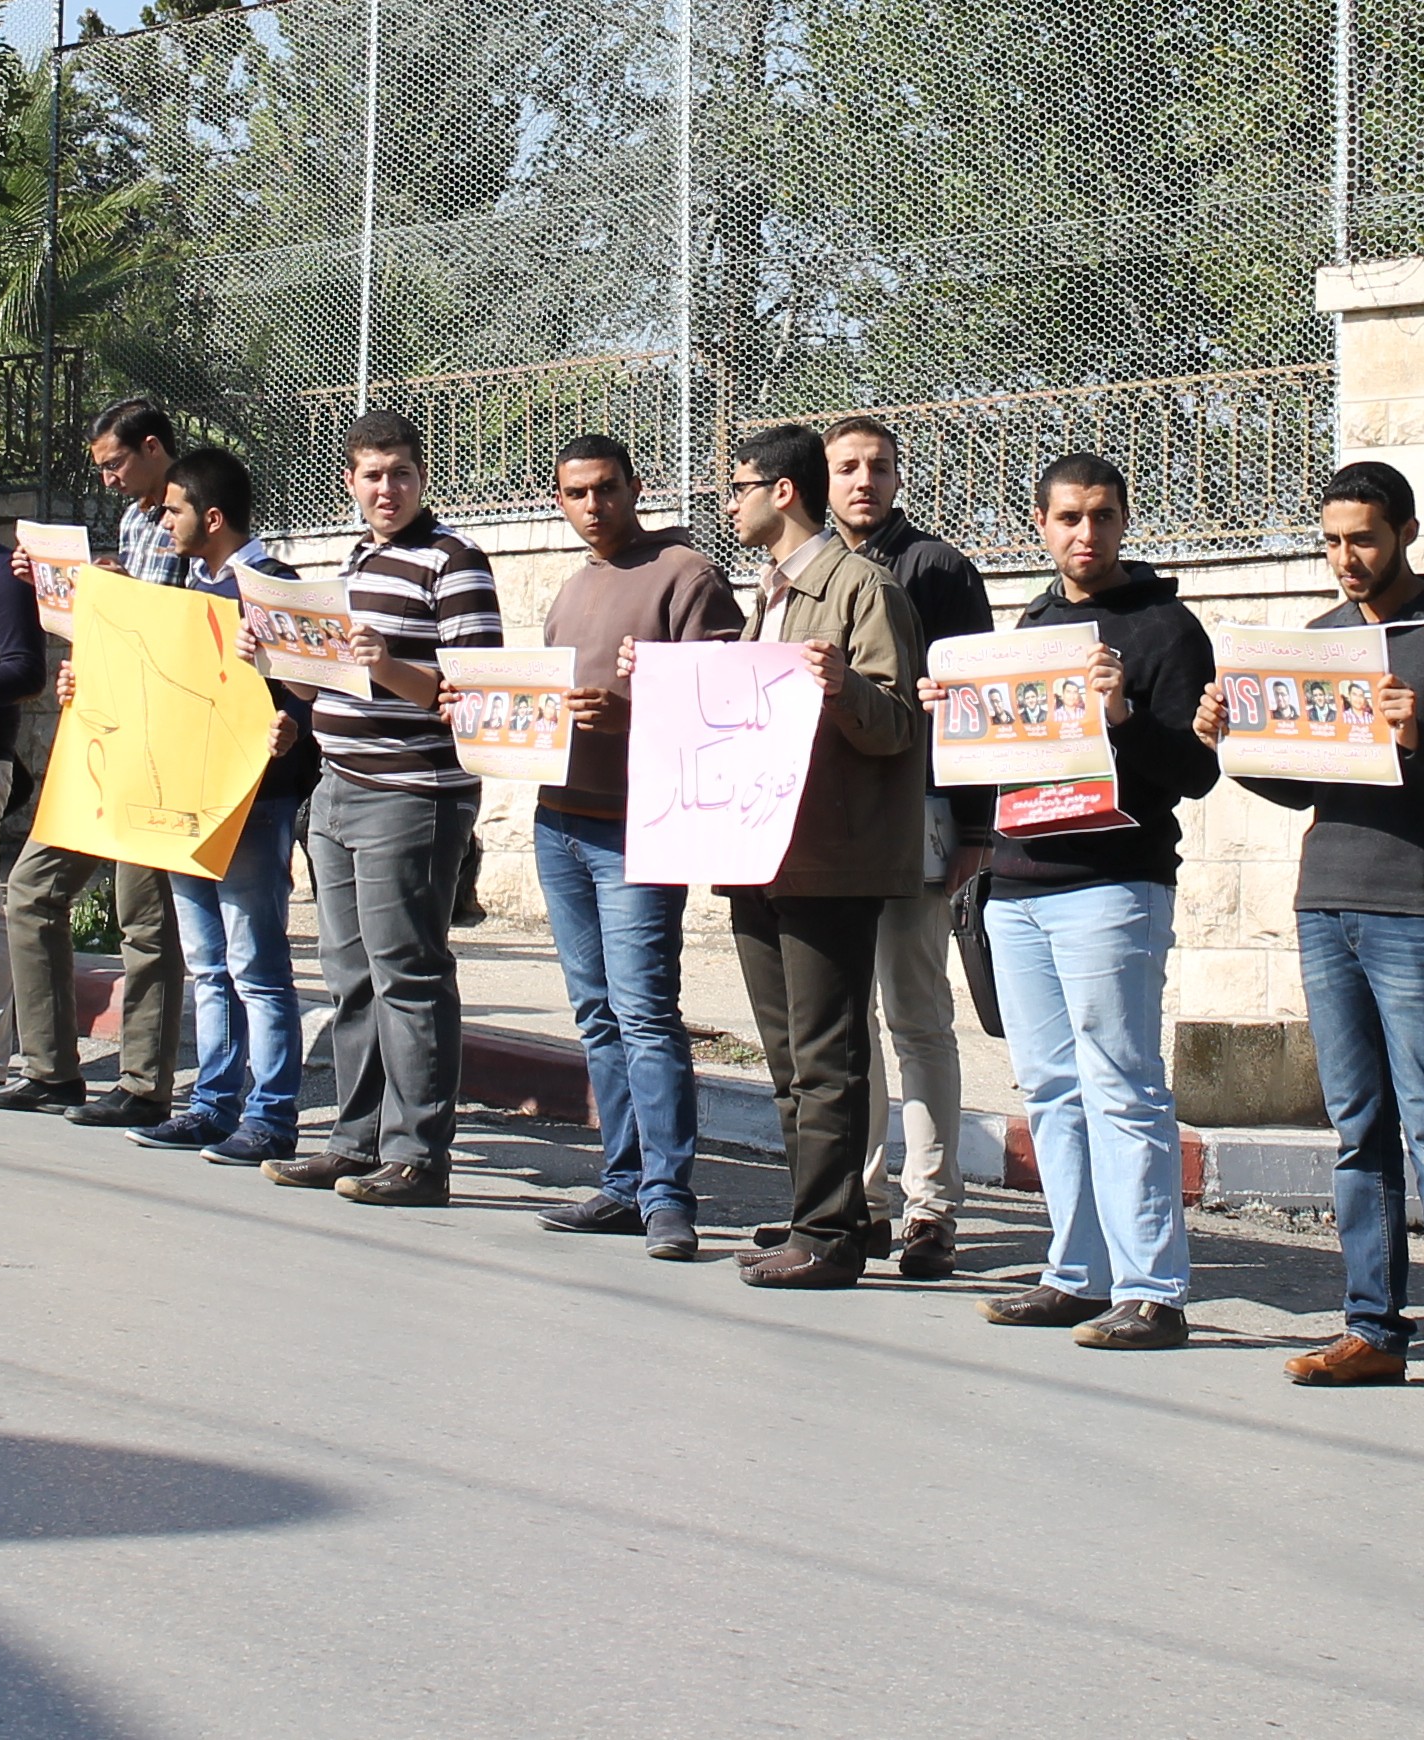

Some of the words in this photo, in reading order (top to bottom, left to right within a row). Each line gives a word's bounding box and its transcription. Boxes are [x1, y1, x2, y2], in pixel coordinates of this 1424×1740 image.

[1272, 644, 1302, 655] جامعة
[1350, 649, 1367, 662] من
[696, 662, 796, 731] كلنا
